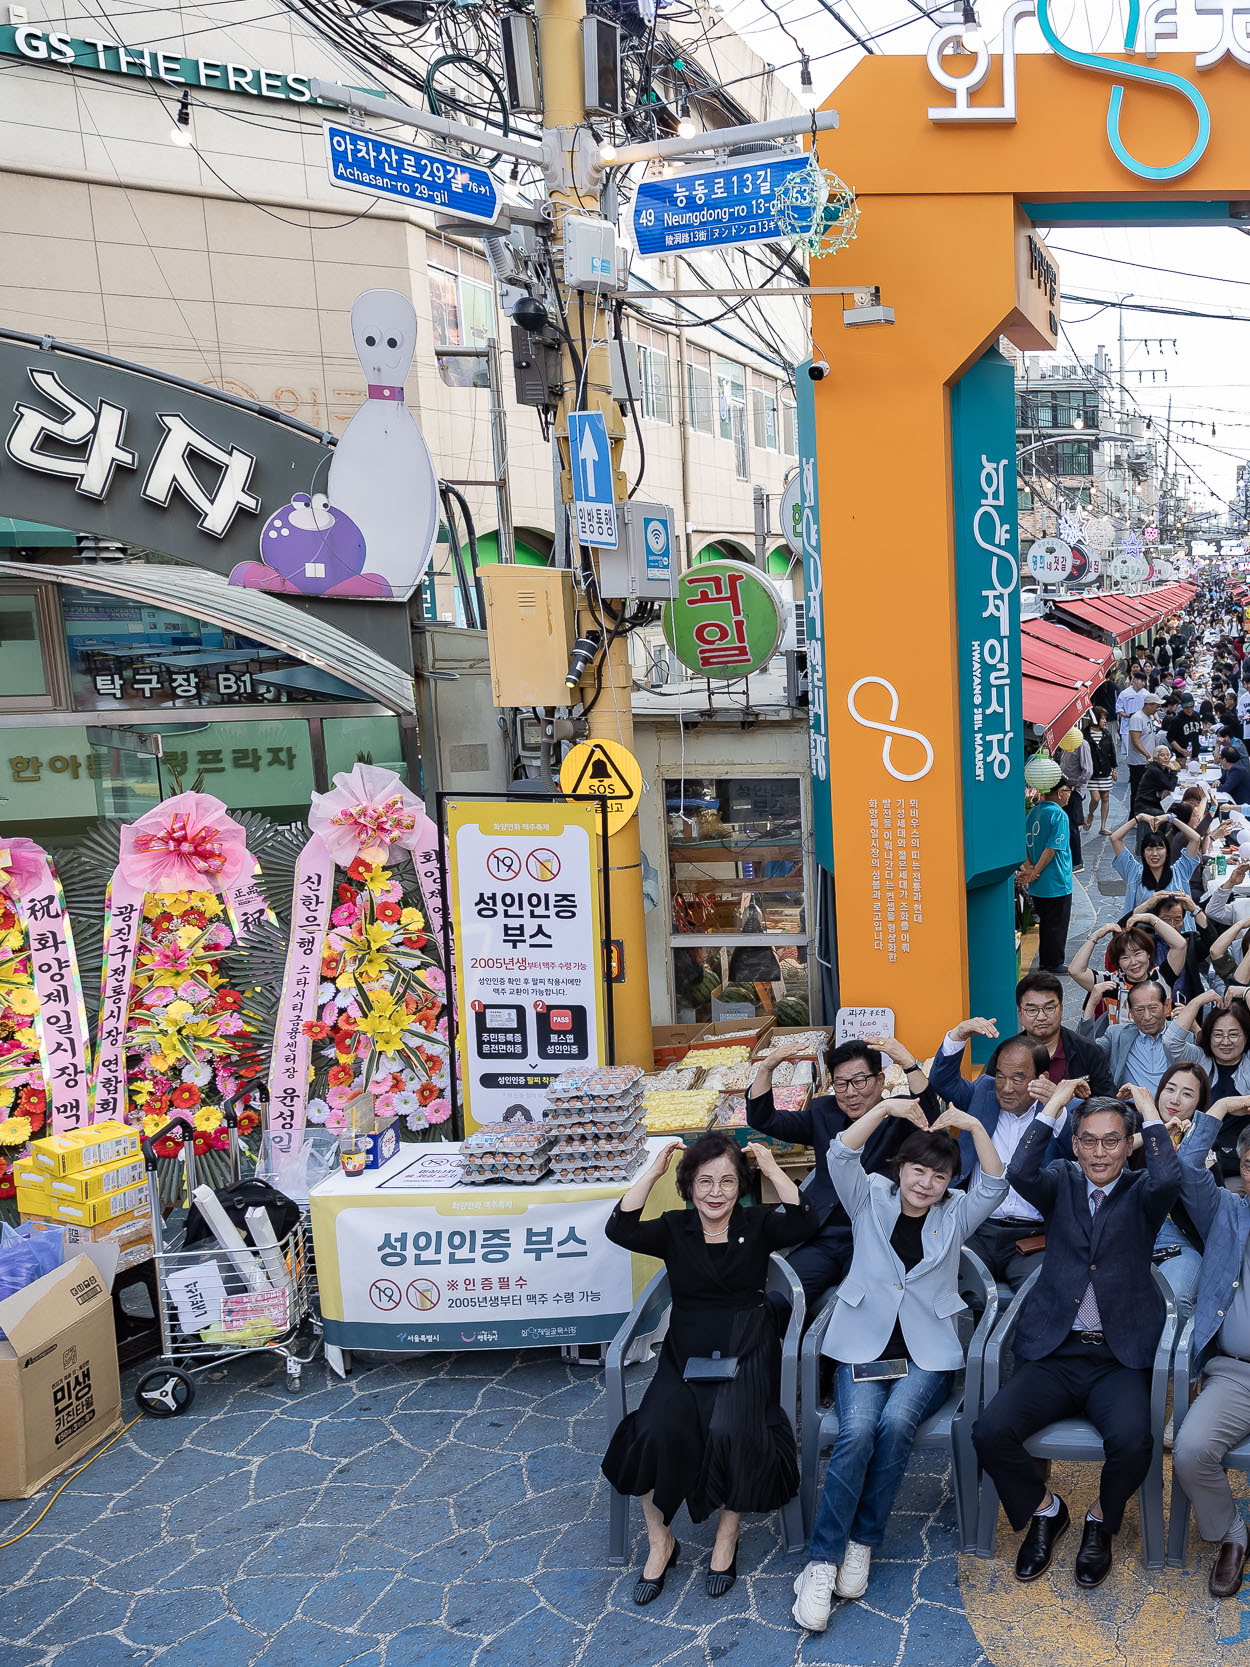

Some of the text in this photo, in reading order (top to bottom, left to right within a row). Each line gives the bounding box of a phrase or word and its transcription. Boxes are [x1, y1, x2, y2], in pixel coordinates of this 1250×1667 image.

[15, 26, 343, 108] GS THE FRES
[333, 135, 463, 193] 아차산로29길
[337, 162, 449, 204] Achasan-ro 29-gil
[674, 168, 771, 207] 능동로13길
[639, 208, 655, 227] 49
[664, 204, 747, 227] Neungdong-ro
[5, 366, 261, 539] 라자
[578, 507, 614, 537] 일방통행
[686, 573, 751, 668] 과일
[95, 671, 200, 699] 탁구장
[971, 641, 985, 782] HWAYANG JEIL MARKET
[589, 784, 615, 794] SOS
[26, 895, 61, 921] 祝
[296, 873, 324, 956] 신한은행
[475, 892, 578, 920] 성인인증
[502, 925, 553, 949] 부스
[573, 962, 587, 971] 가능
[479, 978, 505, 986] 성인인증
[507, 978, 521, 986] 확인
[523, 978, 530, 986] 후
[547, 978, 581, 986] 착용시에만
[493, 988, 507, 996] 맥주
[531, 988, 568, 996] 가능합니다.
[33, 930, 85, 1089] 화양제일시장
[95, 904, 138, 1116] 광진구전통시장 연합회
[283, 964, 310, 1079] 스타시티금융센터장
[482, 1033, 522, 1042] 주민등록증
[482, 1045, 523, 1054] 운전면허증
[546, 1045, 579, 1054] 성인인증
[497, 1076, 526, 1085] 성인인증
[377, 1226, 588, 1267] 성인인증 부스
[447, 1290, 601, 1310] 2005년생부터 맥주 수령 가능
[407, 1334, 440, 1342] 서울특별시
[53, 1367, 92, 1417] 민생
